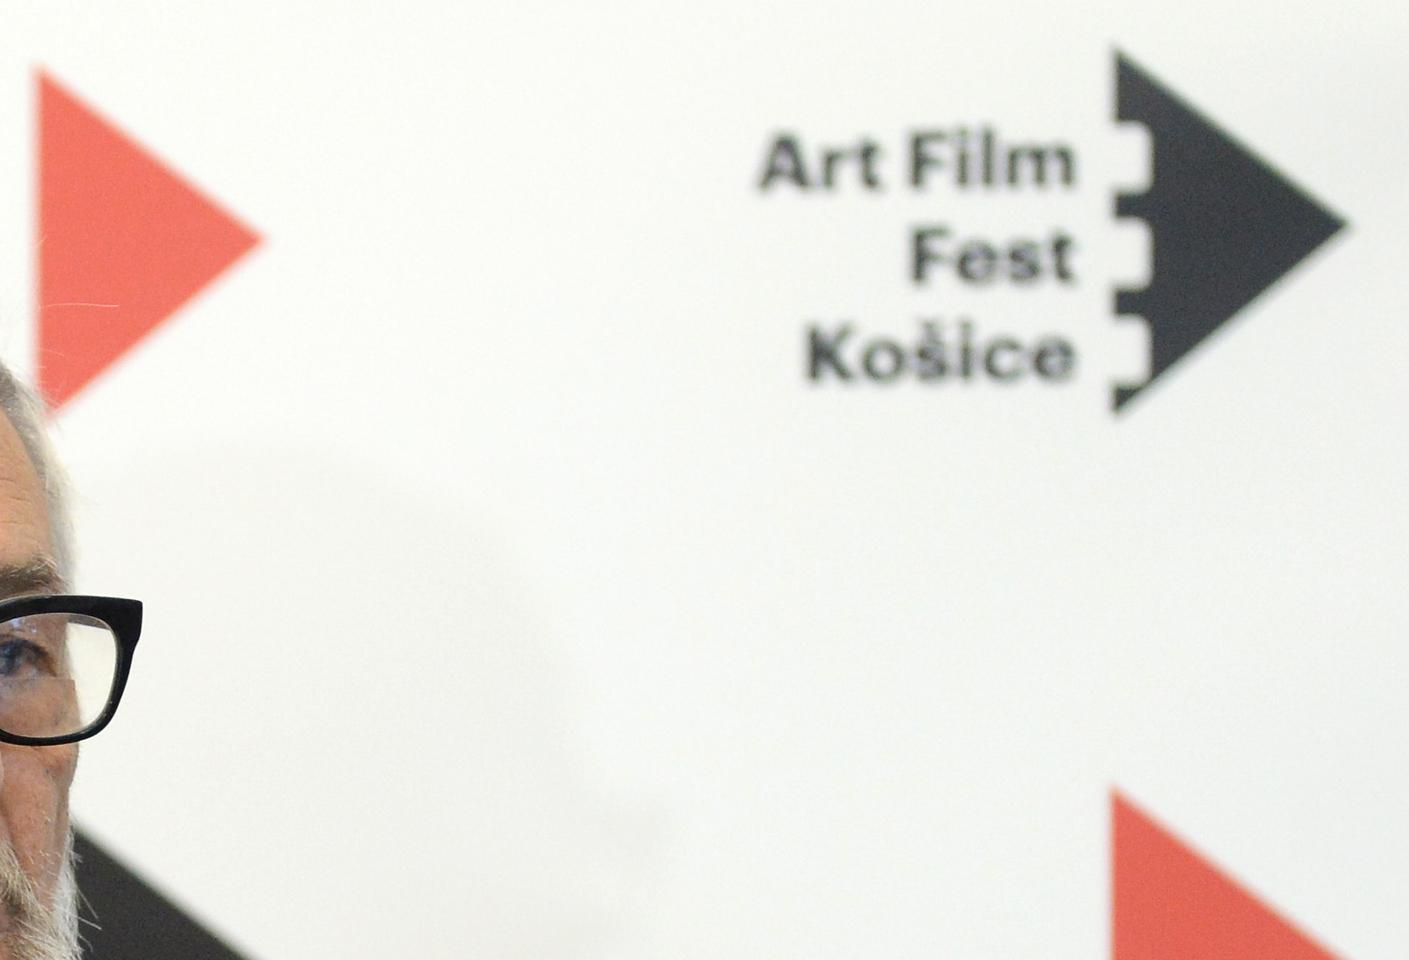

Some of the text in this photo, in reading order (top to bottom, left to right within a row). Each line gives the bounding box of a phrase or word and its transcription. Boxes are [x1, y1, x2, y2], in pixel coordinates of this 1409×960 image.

[756, 126, 1077, 192] Art Film
[909, 223, 1077, 285] Fest
[804, 321, 1078, 384] Košice
